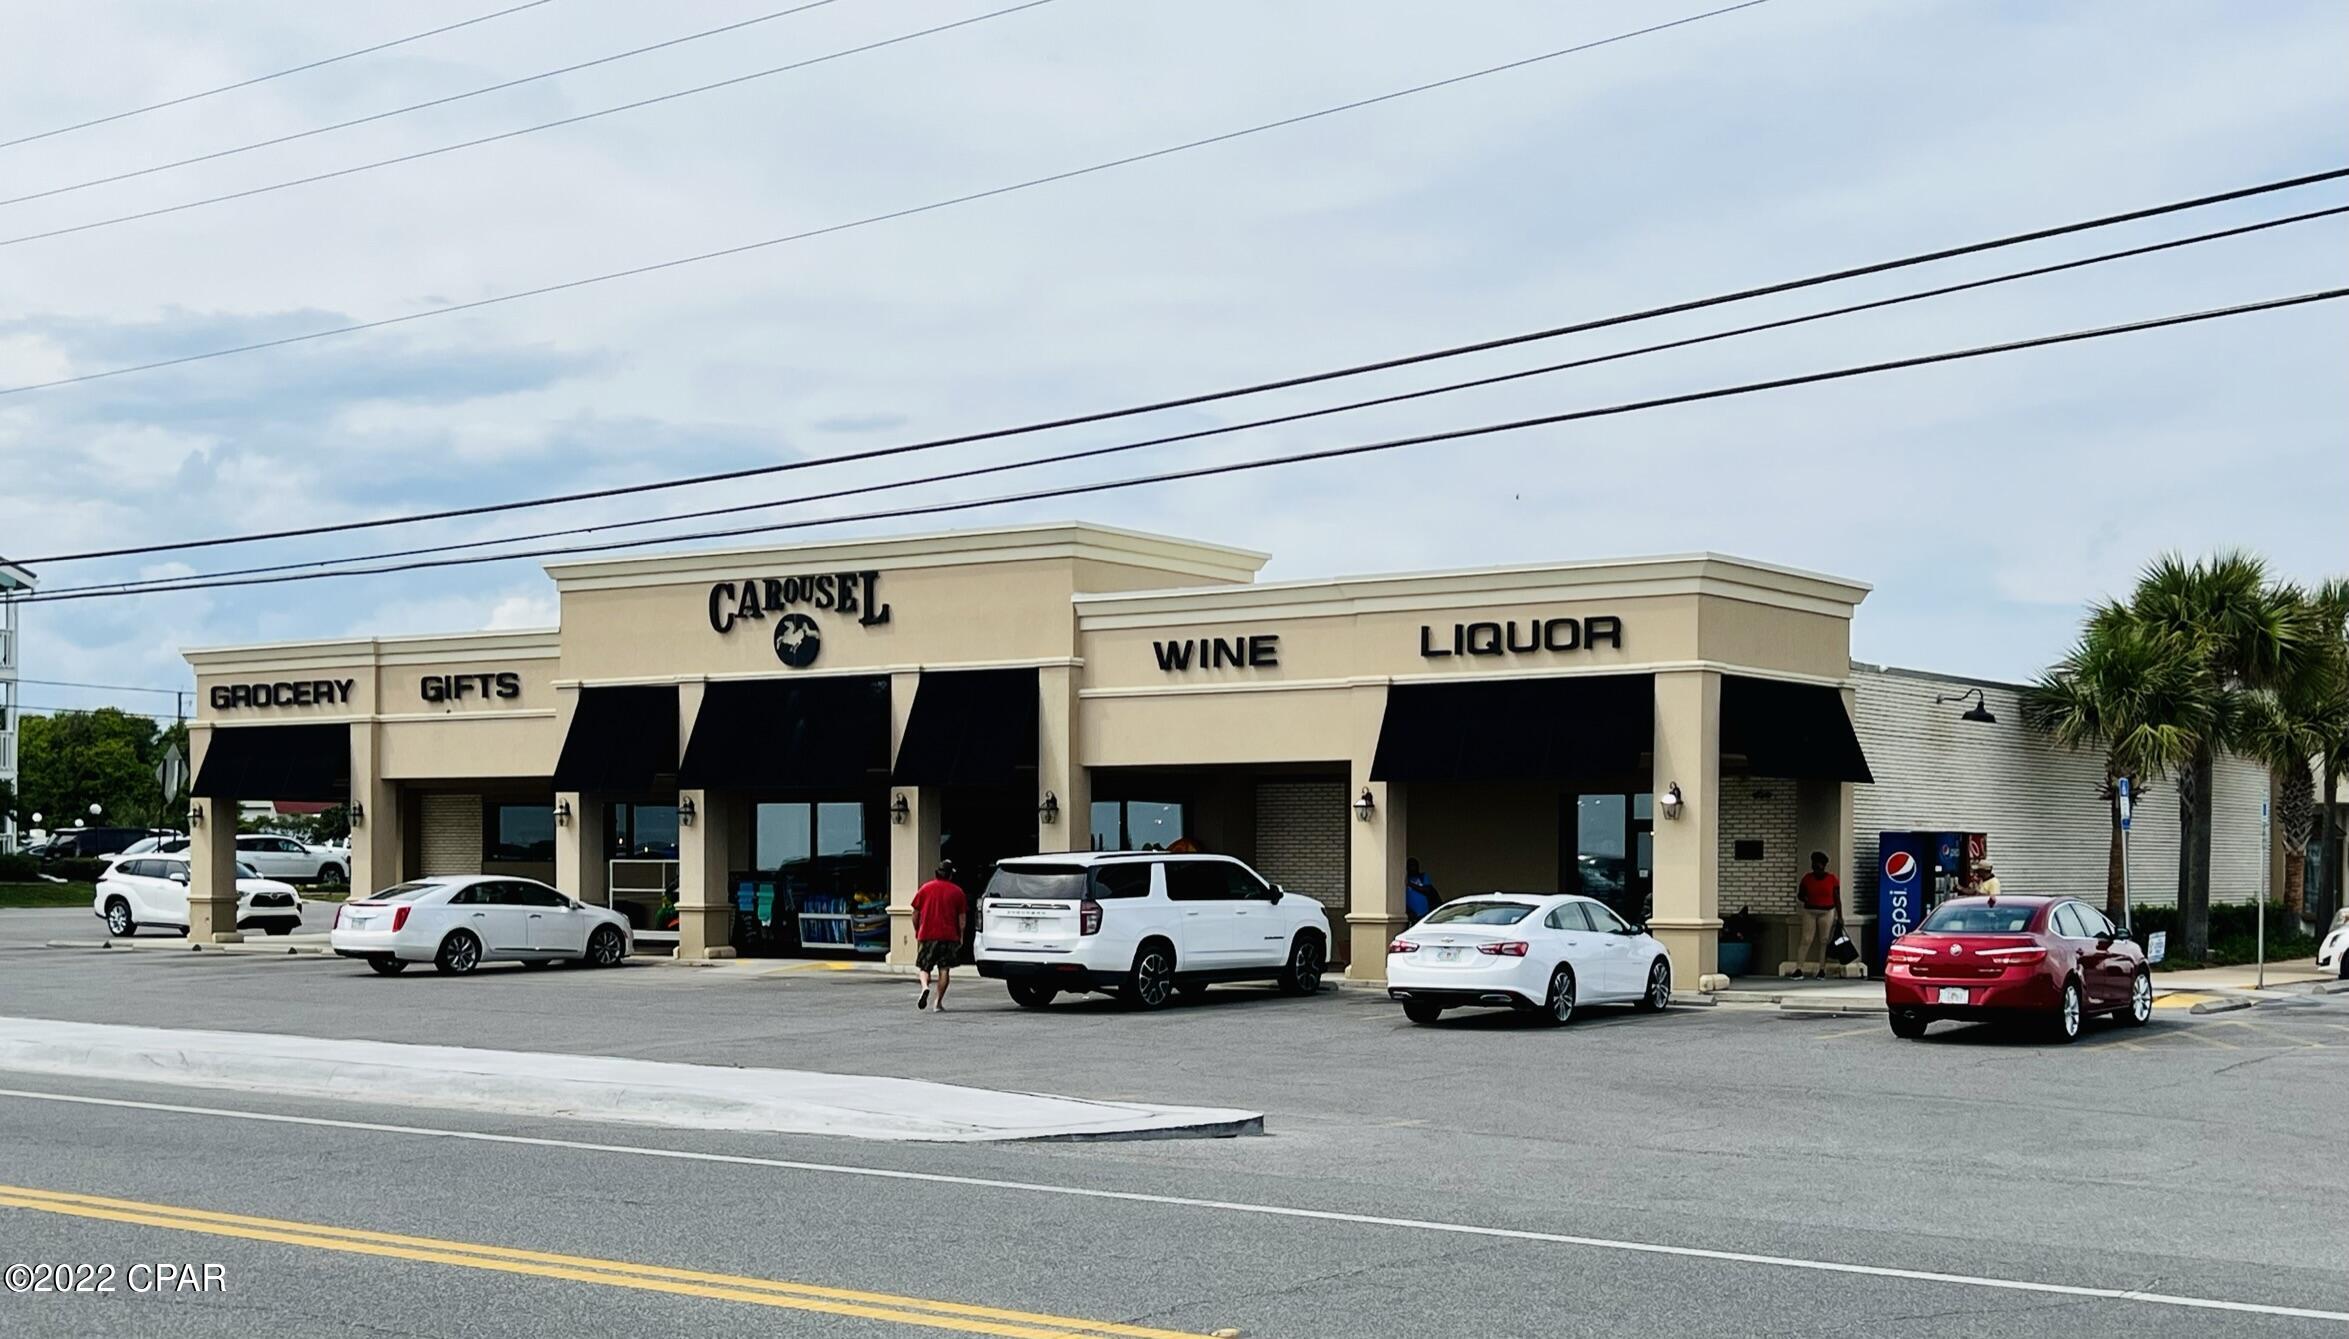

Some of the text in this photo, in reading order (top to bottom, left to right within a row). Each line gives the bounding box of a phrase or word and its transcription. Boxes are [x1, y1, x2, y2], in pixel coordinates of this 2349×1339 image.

[709, 570, 890, 633] CAROUSEL
[1153, 635, 1280, 671] WINE
[1420, 616, 1622, 657] LIQUOR
[210, 679, 354, 710] GROCERY
[421, 672, 520, 703] GIFTS
[1890, 890, 1911, 943] epsi
